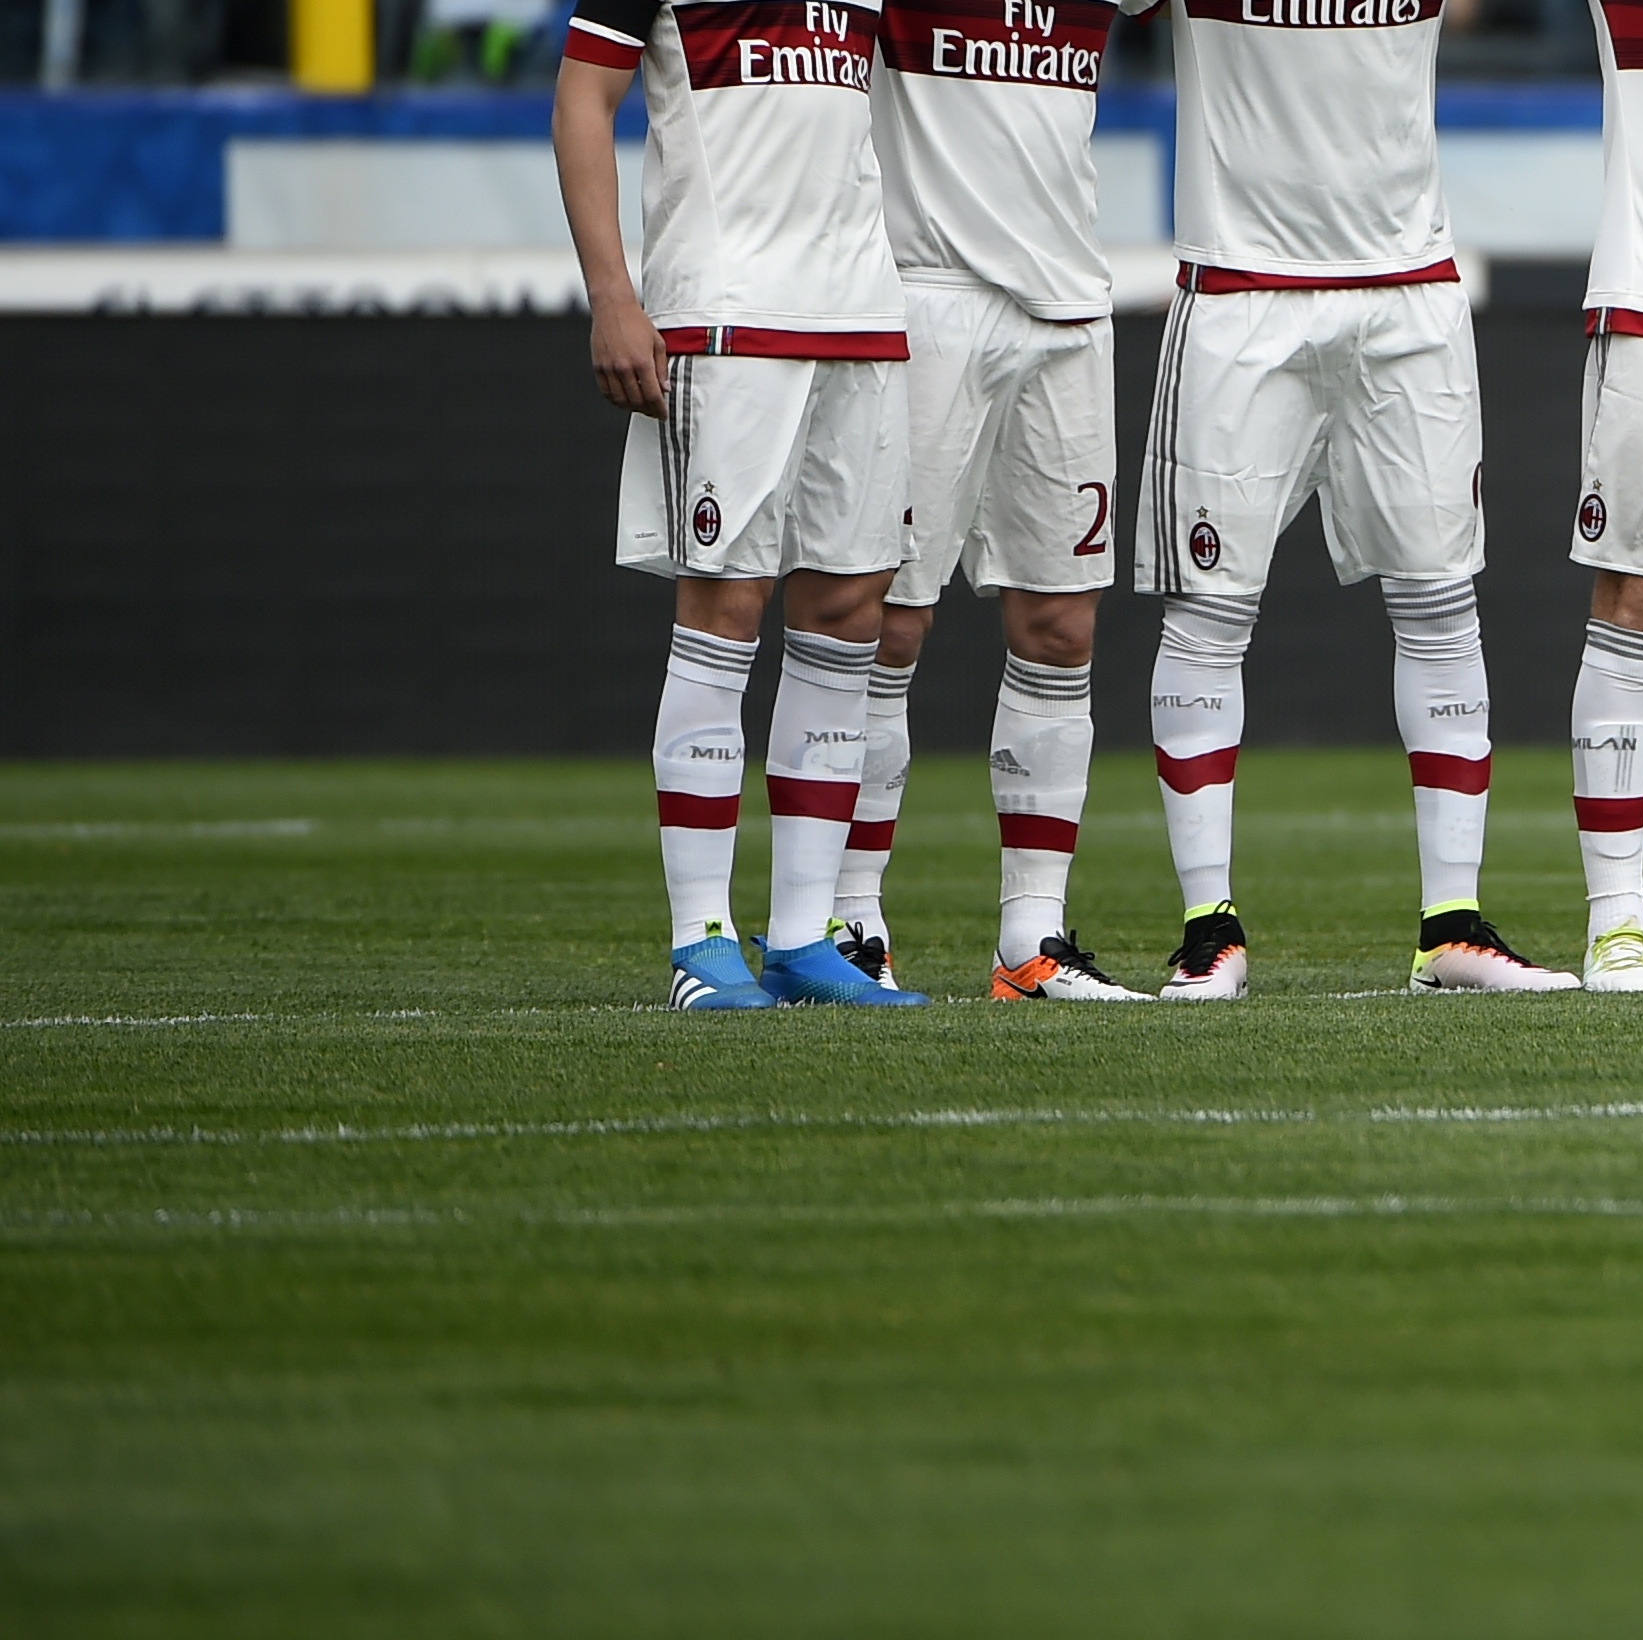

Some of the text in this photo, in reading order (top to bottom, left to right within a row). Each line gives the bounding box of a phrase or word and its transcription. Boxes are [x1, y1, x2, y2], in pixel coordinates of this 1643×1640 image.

[806, 1, 848, 42] Fly
[738, 36, 870, 91] Emirate
[932, 28, 1100, 86] Emirates
[1073, 481, 1117, 557] 2
[1153, 696, 1223, 711] MILAN
[1427, 700, 1488, 719] MILA
[804, 731, 867, 744] MILA
[1572, 737, 1637, 751] MILAN
[690, 745, 744, 760] MILA
